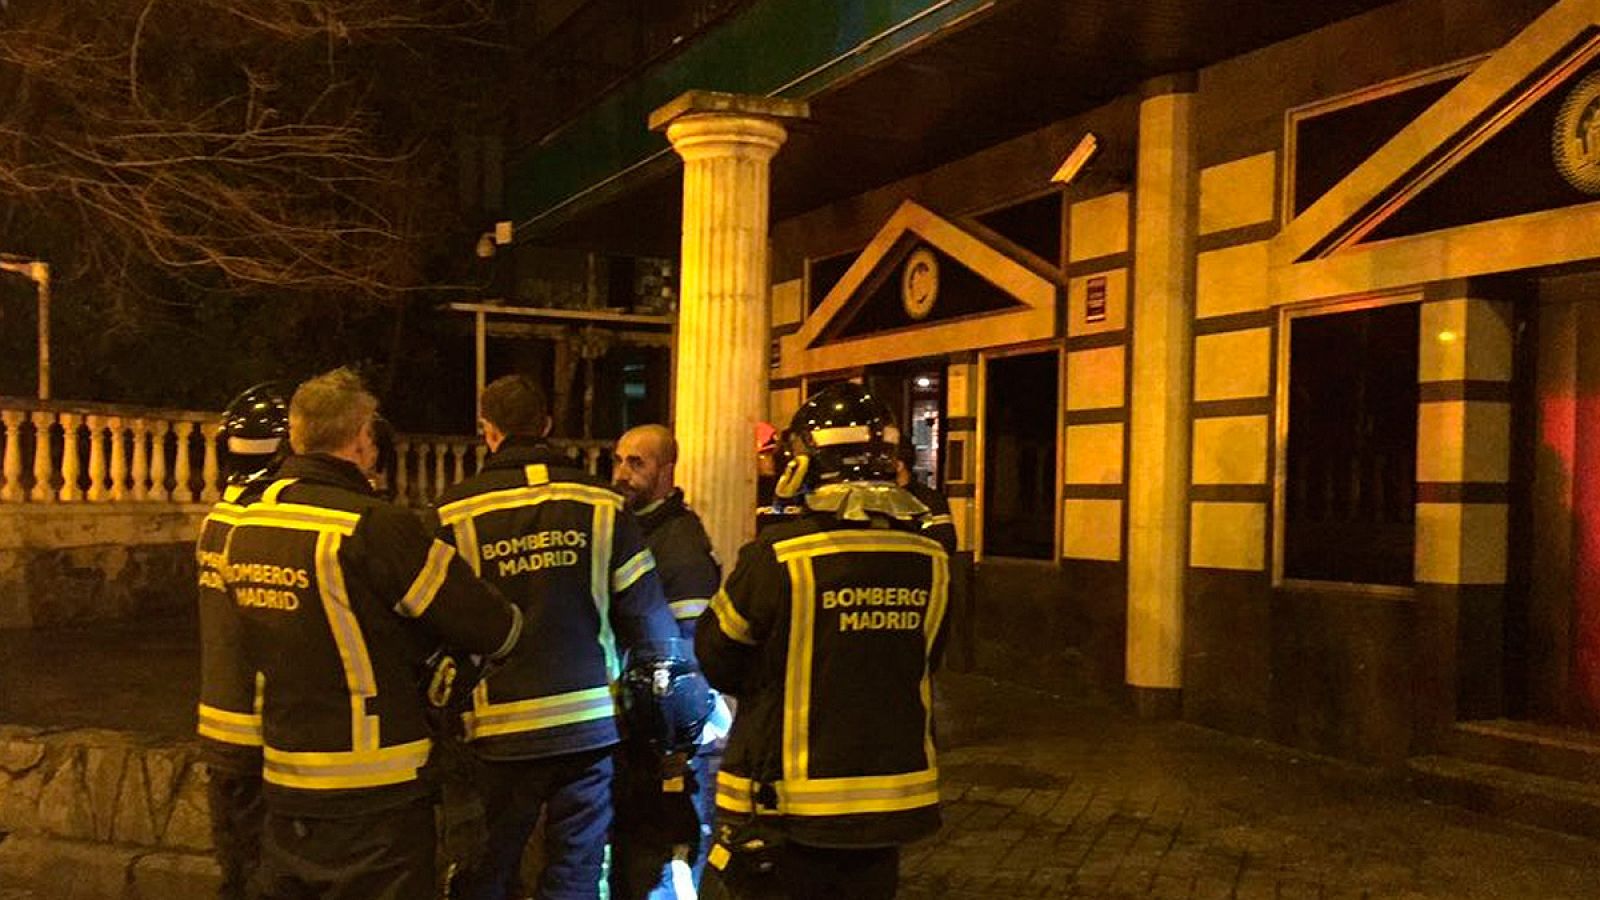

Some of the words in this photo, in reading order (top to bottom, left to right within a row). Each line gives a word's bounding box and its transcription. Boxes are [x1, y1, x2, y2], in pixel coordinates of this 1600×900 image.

[481, 530, 588, 560] BOMBEROS
[498, 550, 578, 577] MADRID
[235, 587, 299, 611] MADRID
[822, 587, 929, 609] BOMBEROS
[840, 611, 920, 632] MADRID
